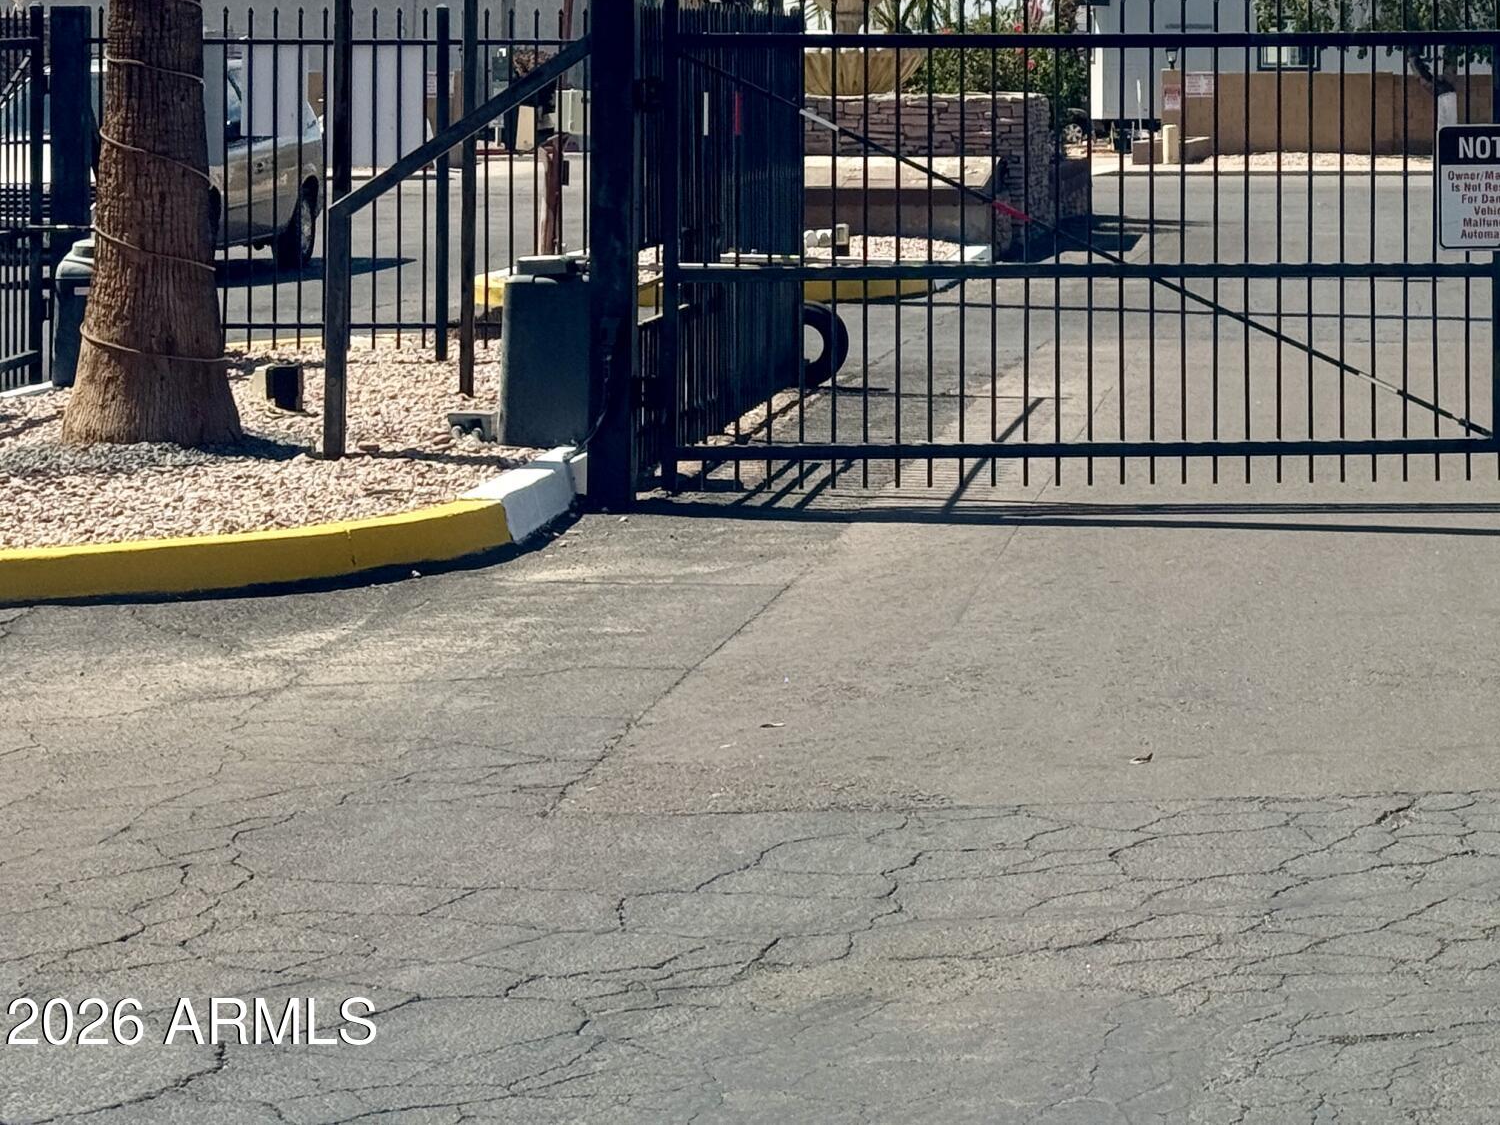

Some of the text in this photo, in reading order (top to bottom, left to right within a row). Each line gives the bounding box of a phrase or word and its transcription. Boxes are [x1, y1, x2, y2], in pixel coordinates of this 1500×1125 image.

[1451, 182, 1461, 192] Is
[1464, 182, 1481, 192] Not
[1461, 194, 1478, 204] For
